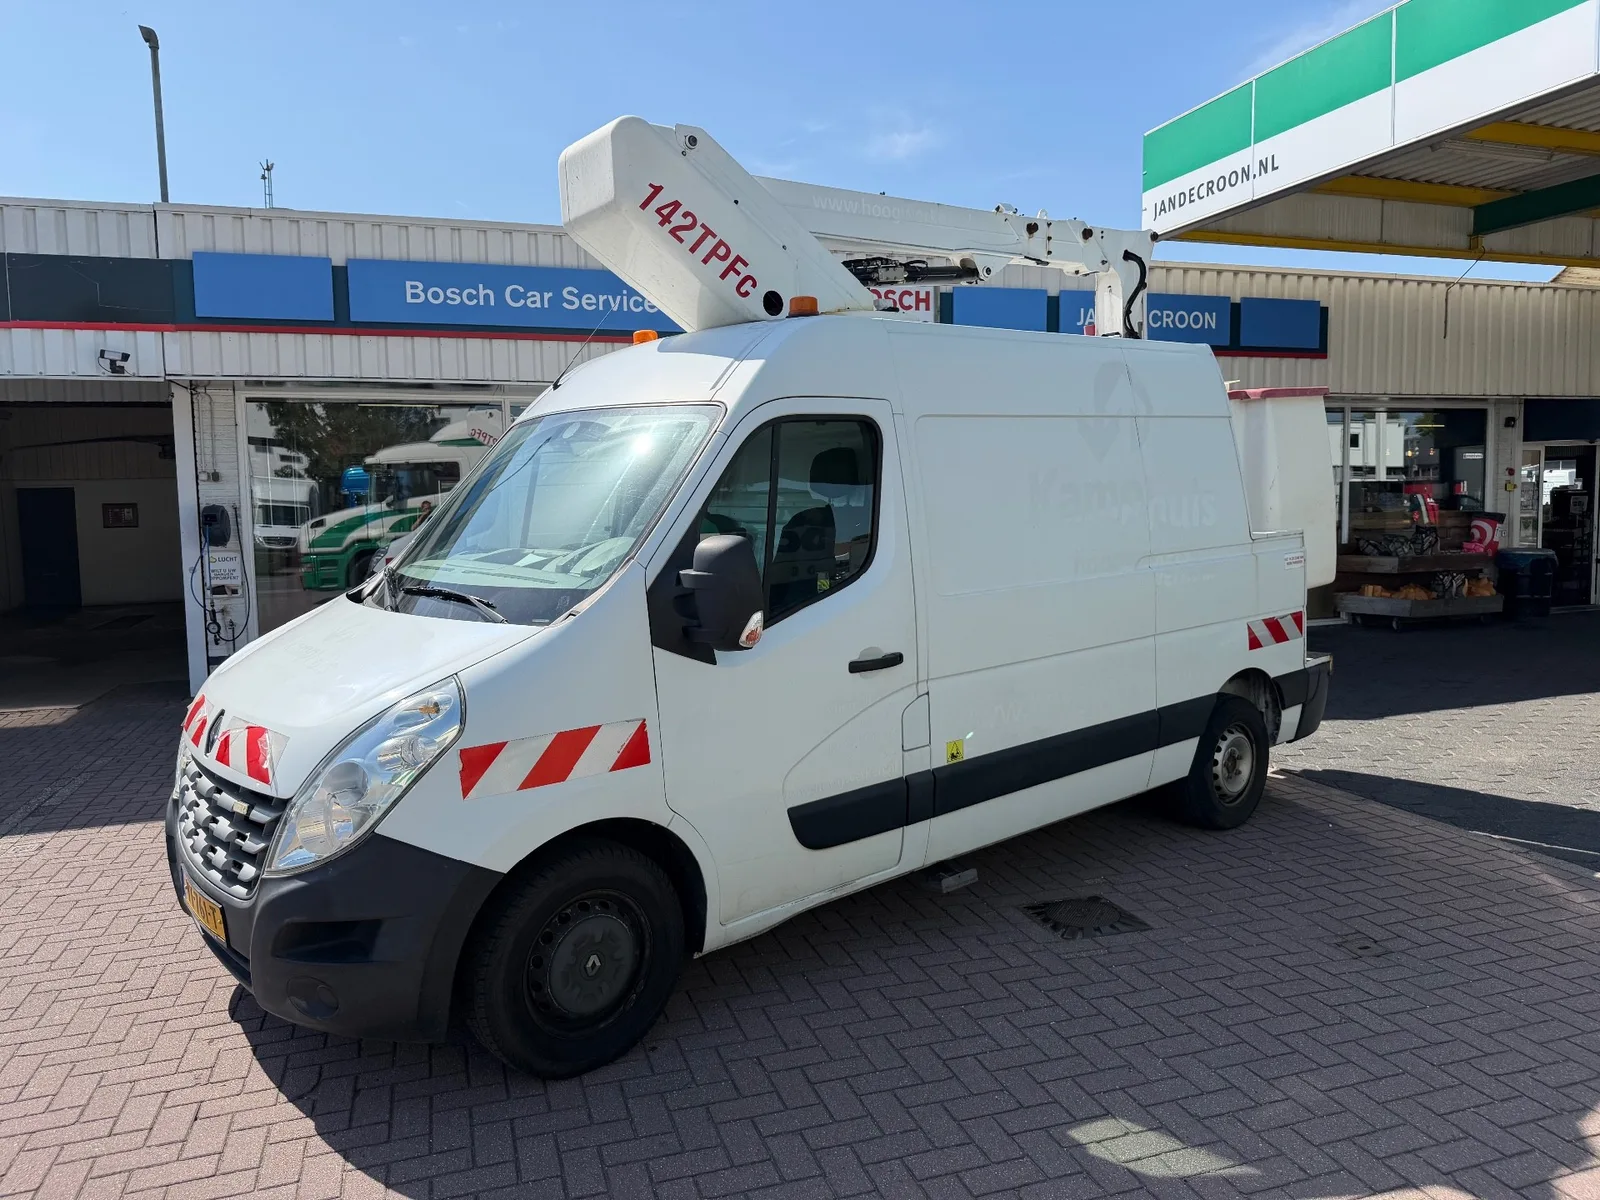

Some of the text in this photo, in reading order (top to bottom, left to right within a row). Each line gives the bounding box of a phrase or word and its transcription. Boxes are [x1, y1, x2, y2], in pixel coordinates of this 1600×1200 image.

[1153, 154, 1280, 221] JANDECROON.NL
[404, 281, 659, 313] Bosch Car Service
[1148, 309, 1217, 329] CROON
